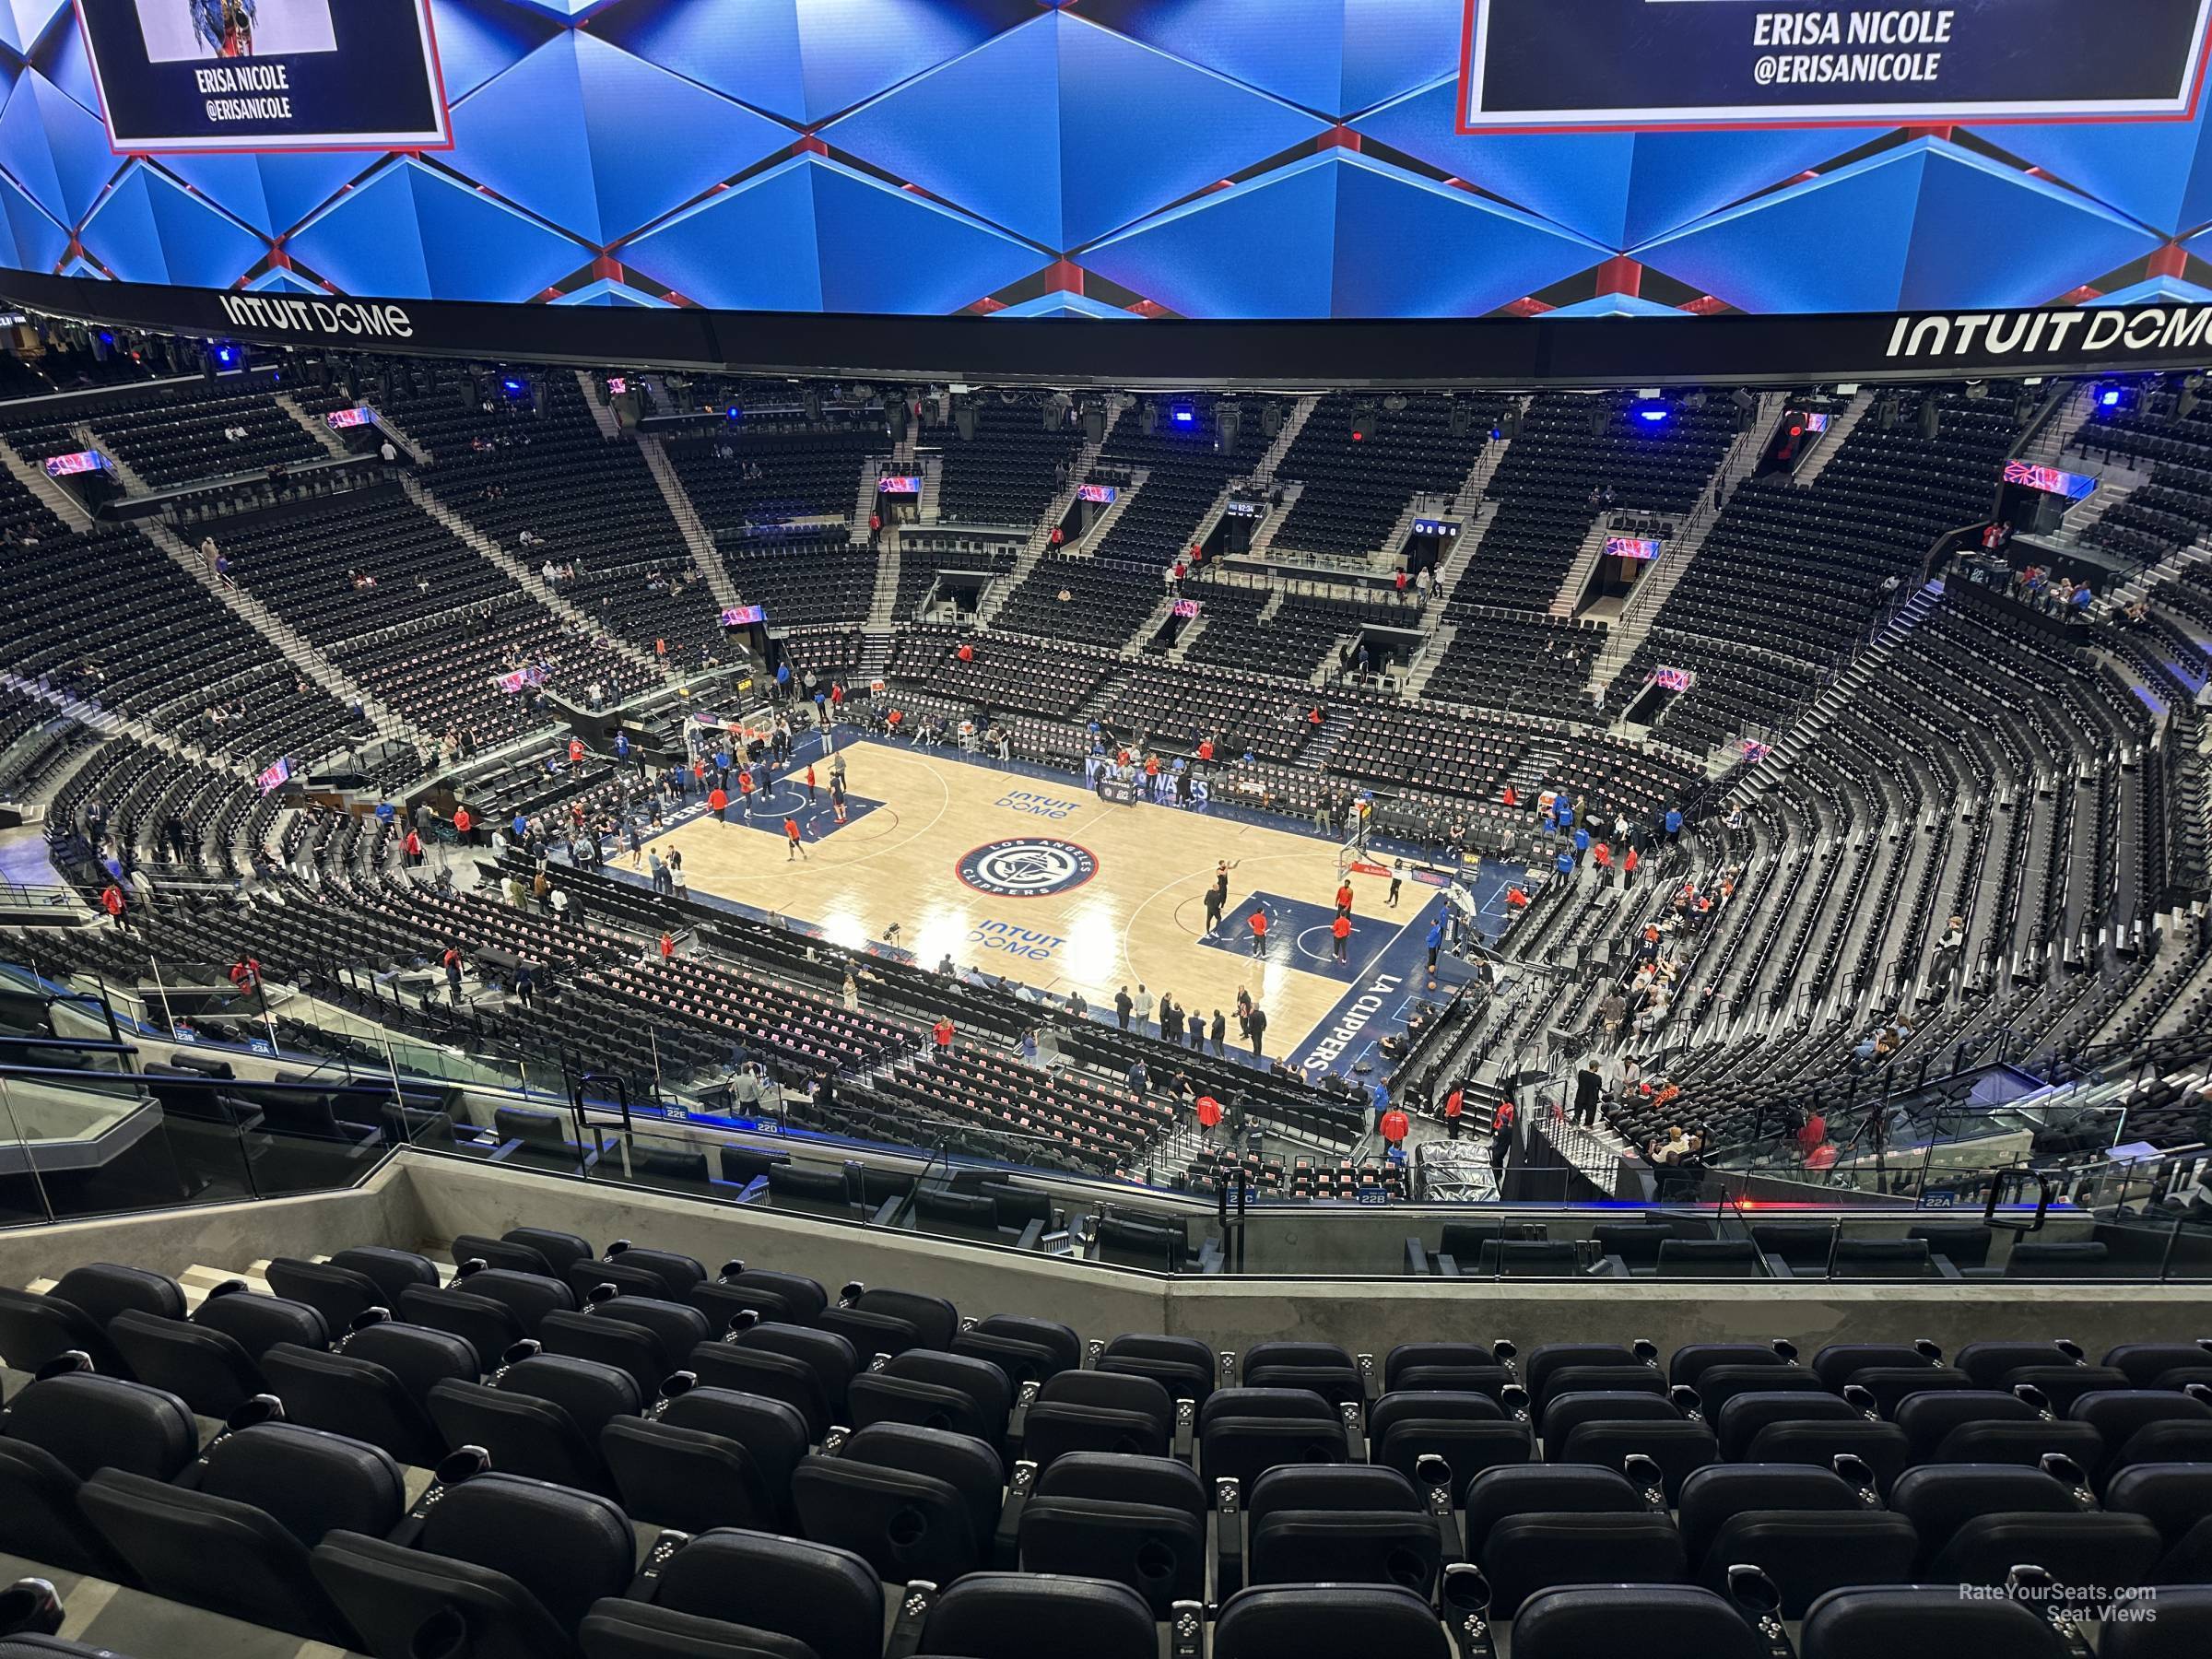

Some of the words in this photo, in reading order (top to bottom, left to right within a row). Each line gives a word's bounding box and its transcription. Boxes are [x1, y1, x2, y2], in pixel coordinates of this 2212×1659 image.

[1753, 12, 1841, 46] ERISA
[1846, 10, 1955, 44] NICOLE
[194, 67, 238, 93] ERISA
[234, 65, 289, 91] NICOLE
[1753, 53, 1941, 85] @ERISANICOLE
[206, 97, 292, 122] @ERISANICOLE
[2081, 307, 2212, 351] DOM
[989, 840, 1025, 851] LOS
[1039, 840, 1091, 873] ANGELES
[962, 868, 1050, 895] CLIPPERS
[1368, 973, 1403, 994] LA
[1303, 994, 1382, 1071] CLIPPERS
[666, 1109, 687, 1119] 22E
[1230, 1194, 1253, 1203] 2C
[1361, 1194, 1385, 1204] 22B
[1926, 1198, 1950, 1206] 22A
